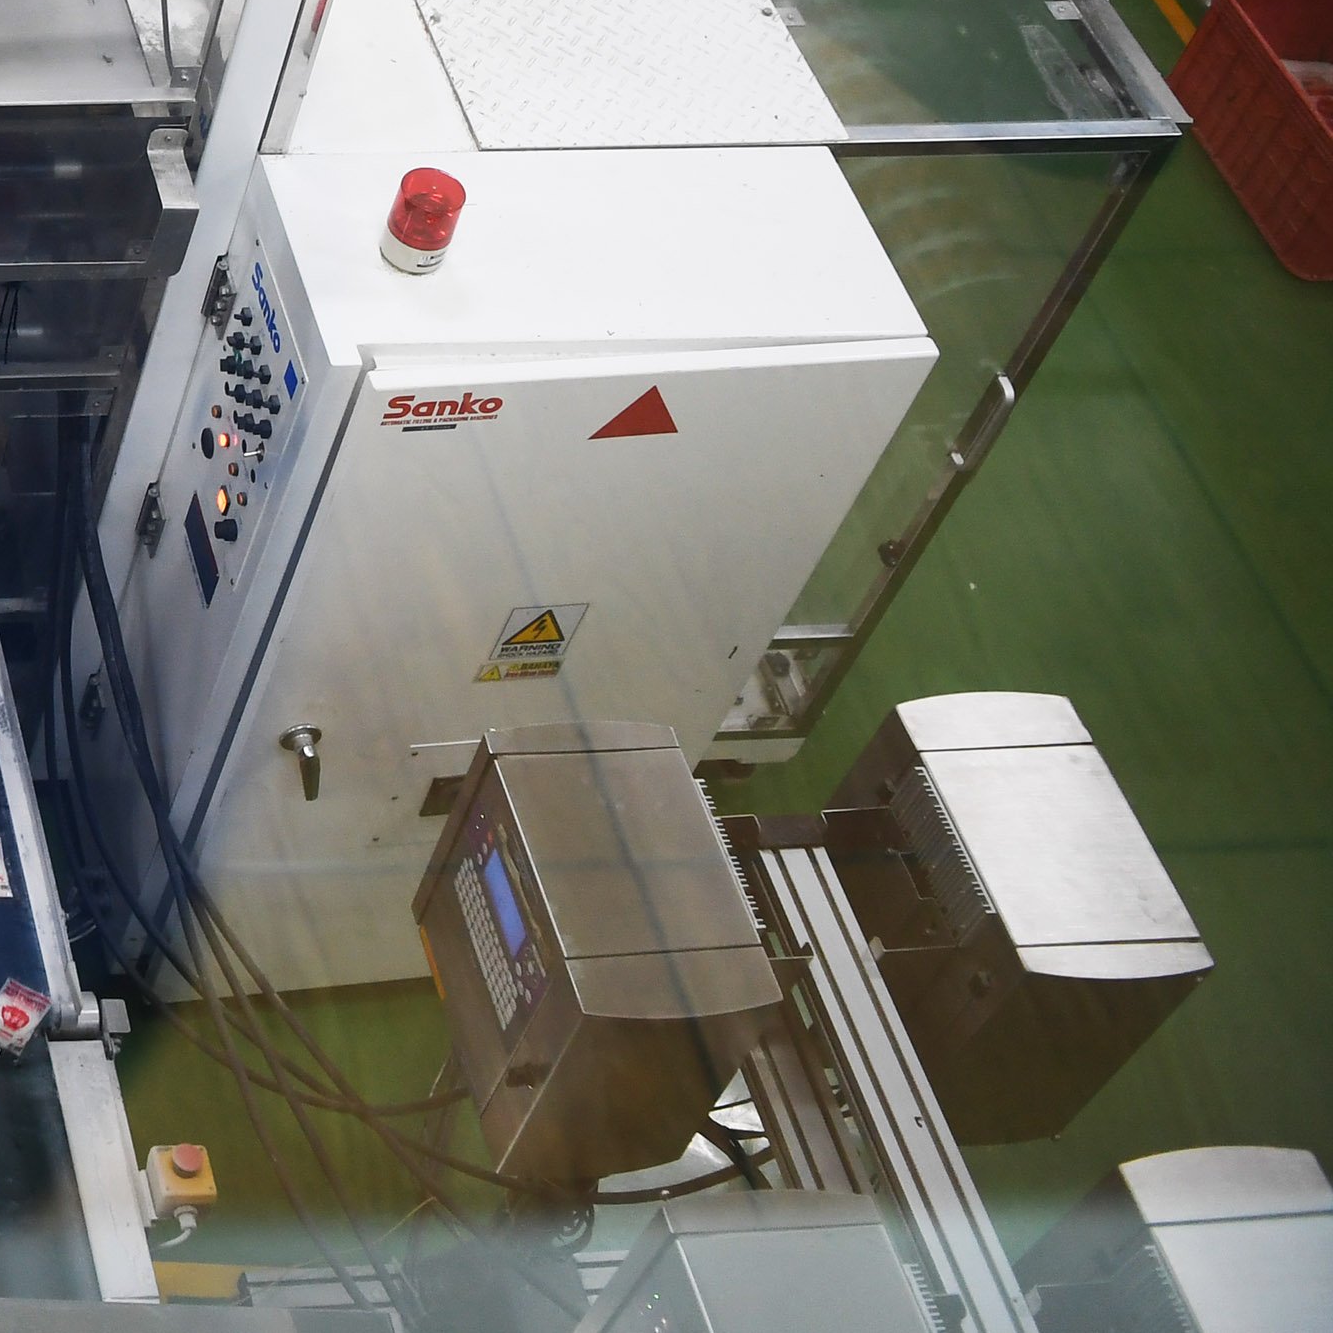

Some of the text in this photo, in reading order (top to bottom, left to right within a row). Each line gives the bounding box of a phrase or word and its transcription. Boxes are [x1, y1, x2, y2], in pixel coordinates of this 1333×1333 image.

[251, 262, 281, 354] Sanko
[383, 392, 503, 420] Sanko
[500, 643, 561, 653] WARNING
